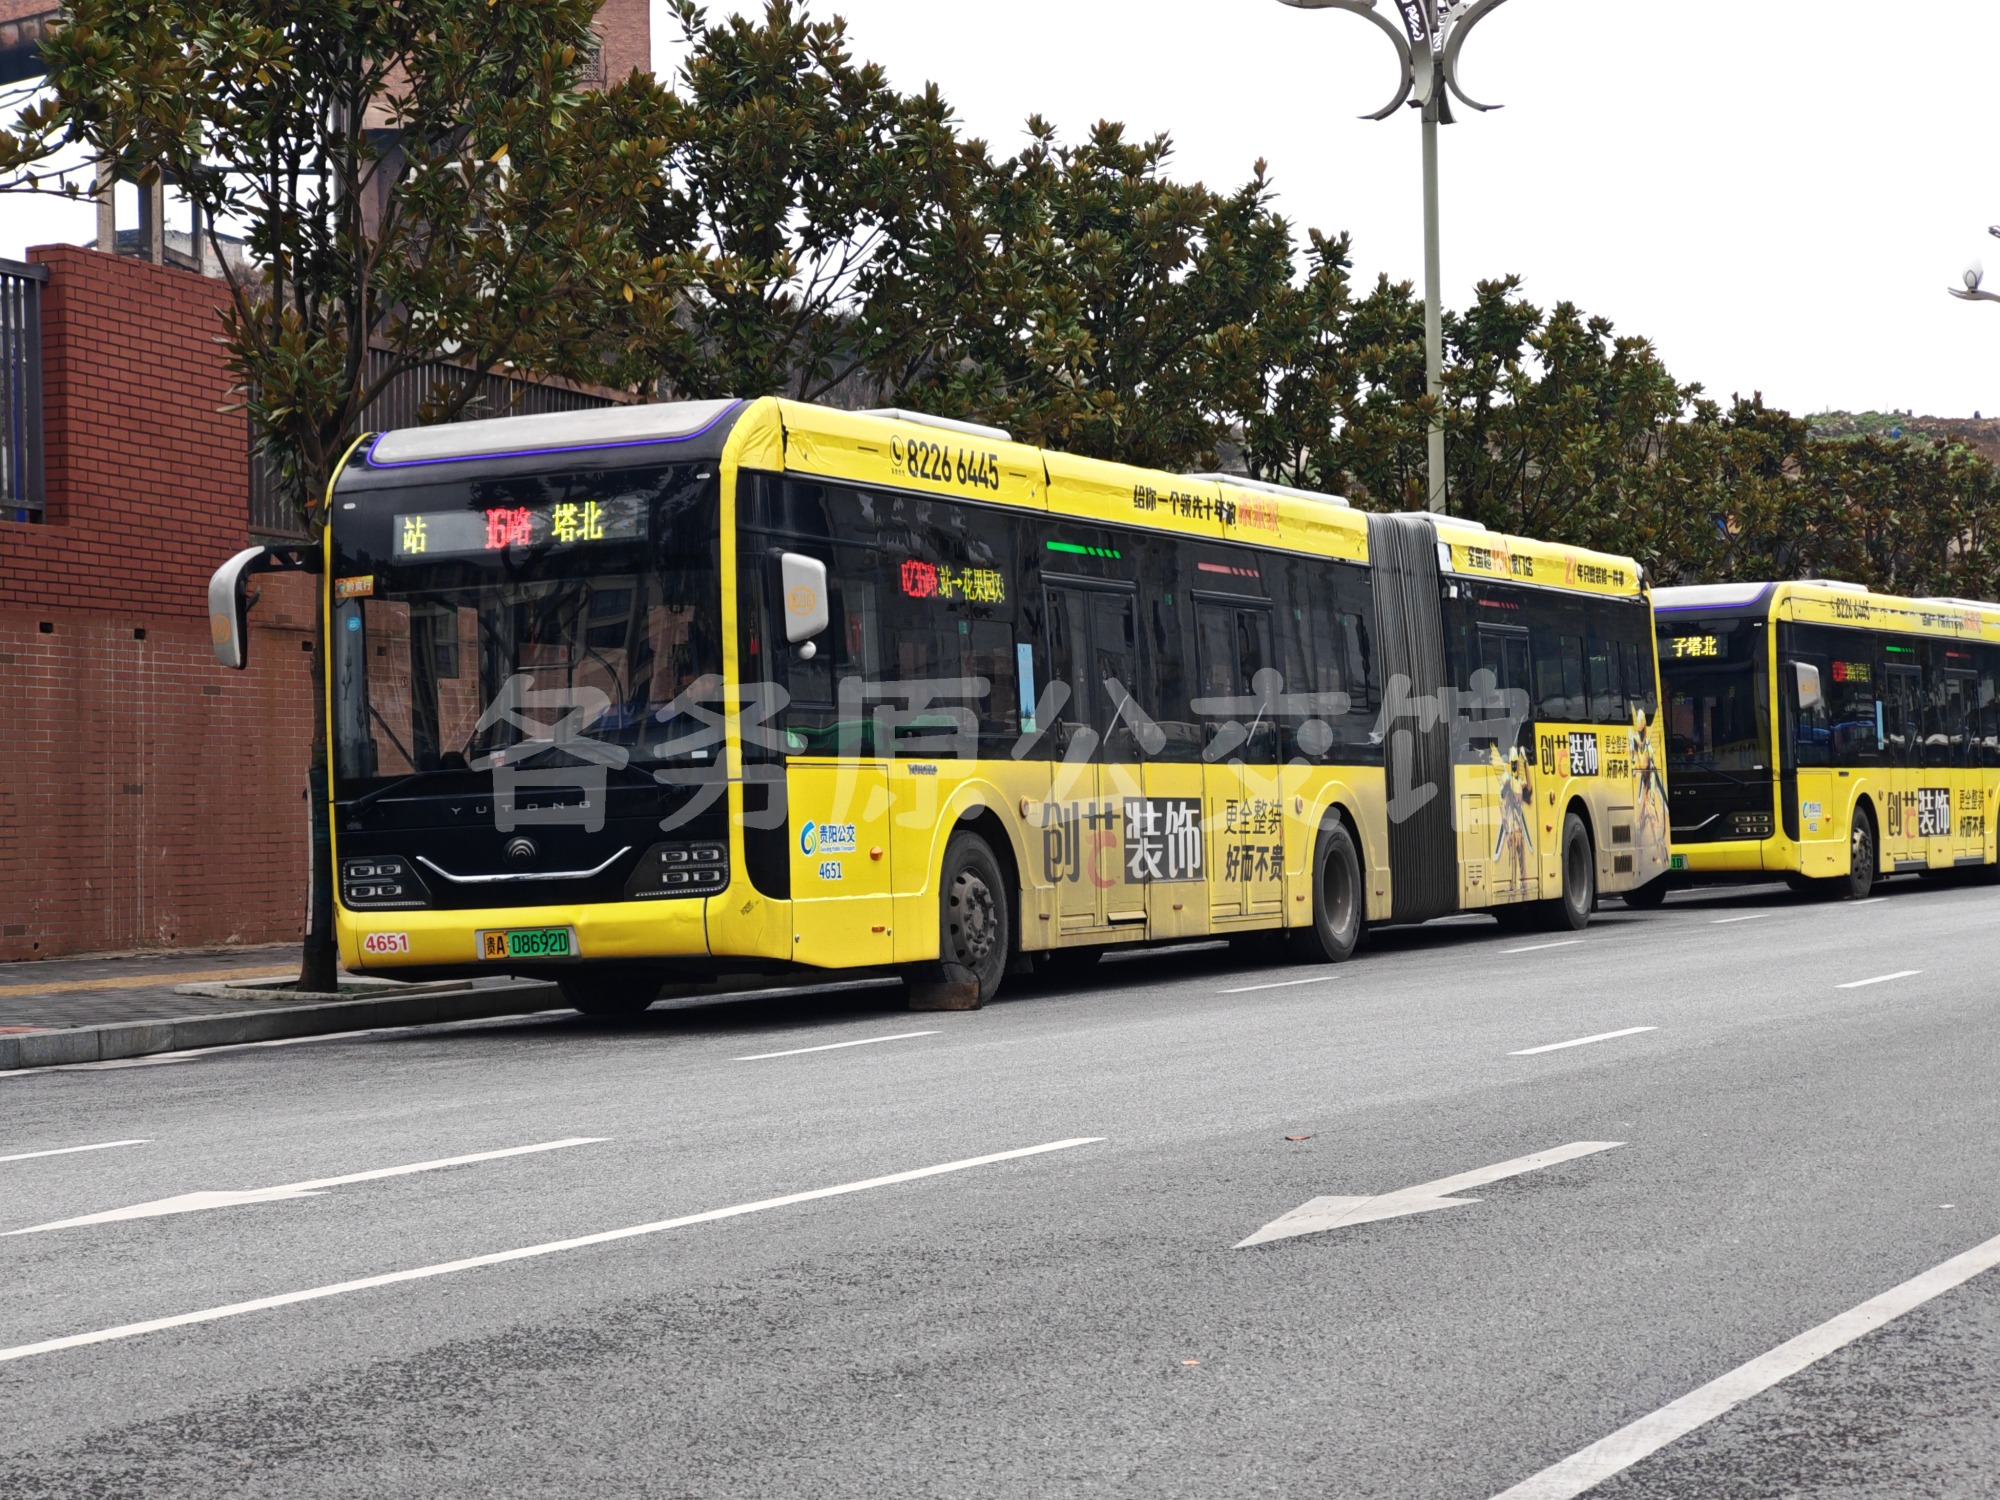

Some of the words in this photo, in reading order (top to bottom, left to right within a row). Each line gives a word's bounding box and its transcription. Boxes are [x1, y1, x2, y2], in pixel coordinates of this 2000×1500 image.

[907, 439, 951, 482] 8226
[957, 448, 999, 490] 6445
[403, 515, 427, 554] 站
[552, 501, 602, 542] 塔北
[1672, 636, 1717, 657] 子塔北
[1606, 760, 1629, 779] 好而不贵
[451, 801, 591, 815] YUTONG
[1224, 799, 1283, 836] 更全整装
[819, 824, 855, 844] 贵阳公交
[1959, 815, 1984, 838] 好而不贵
[1041, 801, 1201, 889] 创艺装饰
[819, 862, 842, 879] 4651
[1225, 845, 1284, 882] 好而不贵
[365, 934, 409, 953] 4651
[485, 935, 506, 956] 贵A
[511, 930, 568, 954] 08692D
